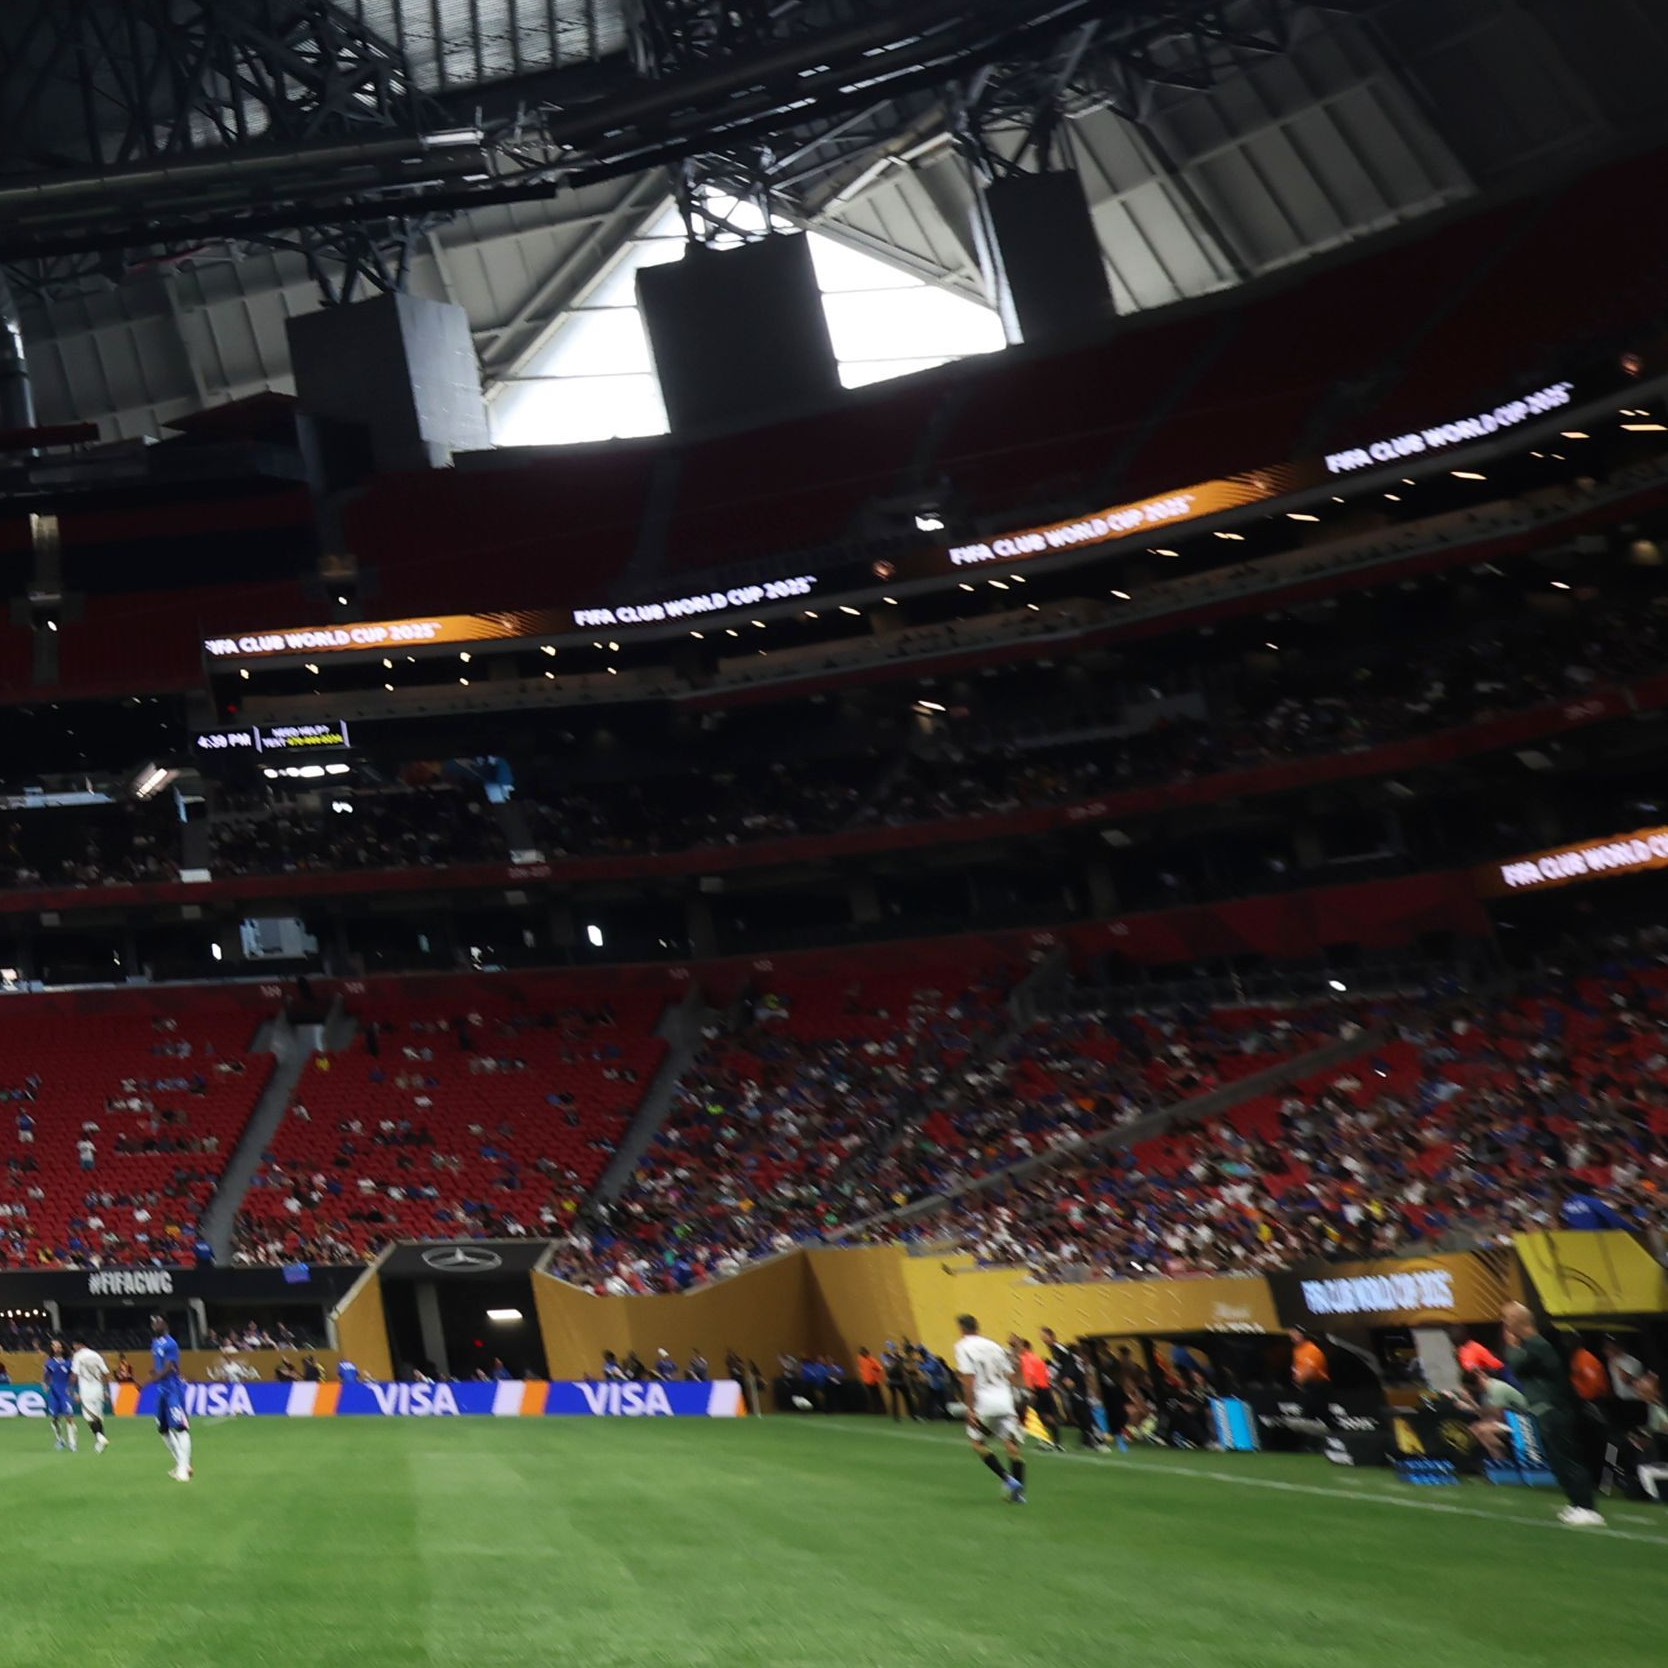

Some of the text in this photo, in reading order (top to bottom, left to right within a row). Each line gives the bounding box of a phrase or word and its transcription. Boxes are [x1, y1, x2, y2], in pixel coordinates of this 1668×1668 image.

[615, 603, 665, 623] CLUB
[726, 584, 764, 606] CUP
[237, 636, 285, 653] CLUB
[351, 626, 387, 645] CUP
[363, 1382, 462, 1416] VISA
[572, 1381, 675, 1417] VISA
